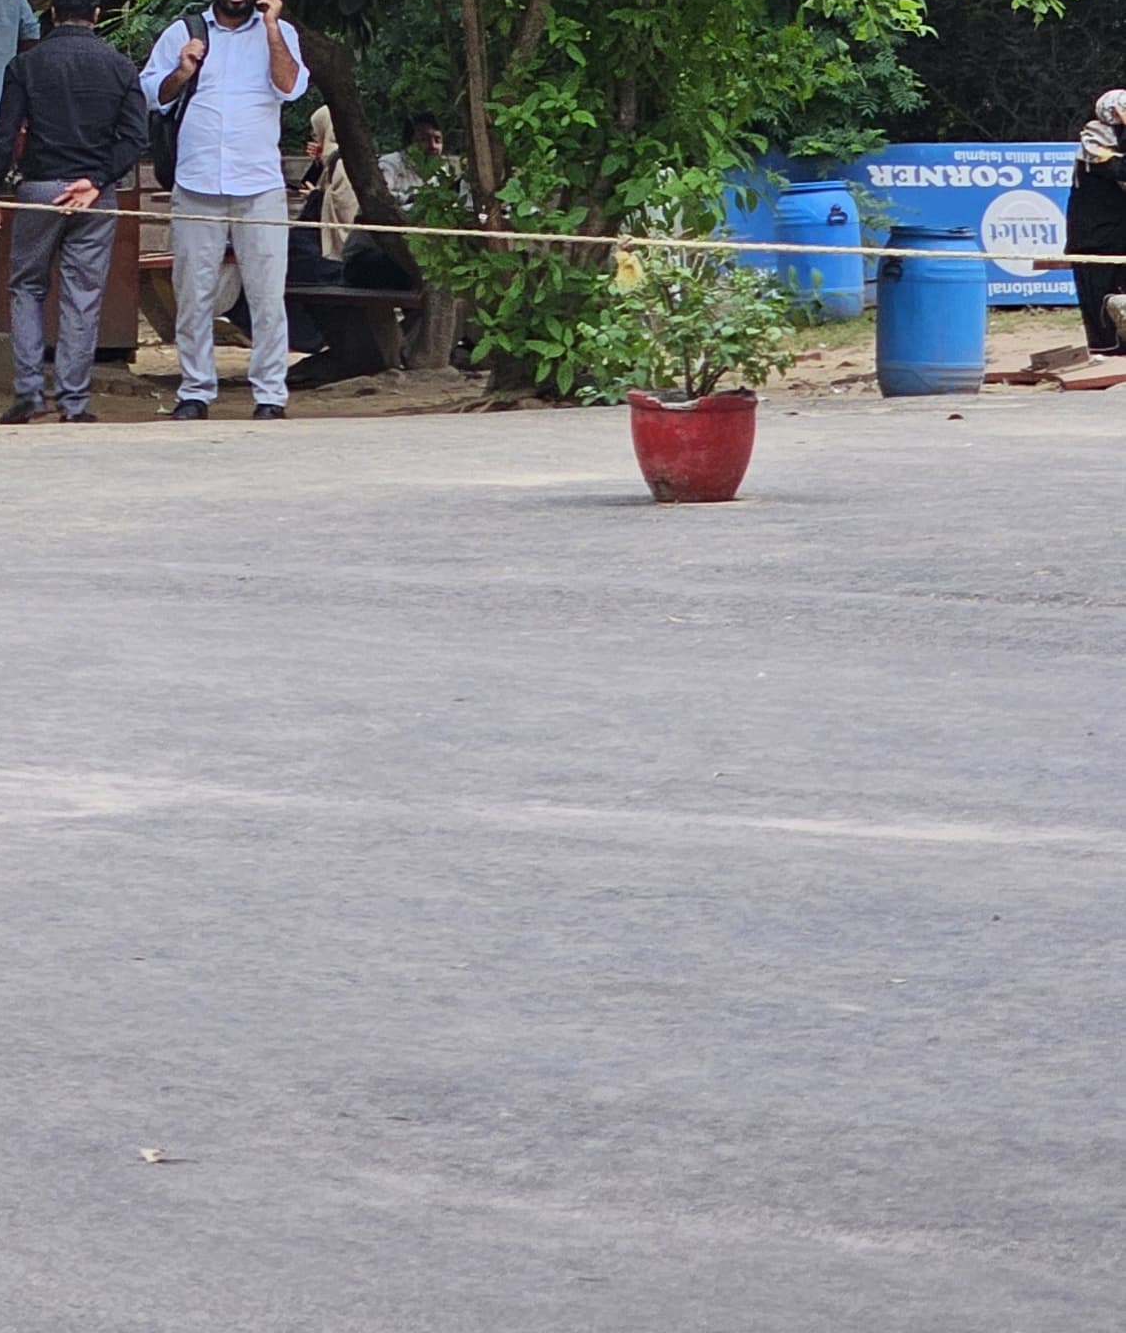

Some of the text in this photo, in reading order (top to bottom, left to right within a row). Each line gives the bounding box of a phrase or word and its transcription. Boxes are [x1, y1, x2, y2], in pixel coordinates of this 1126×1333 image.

[1043, 151, 1075, 163] amia
[866, 165, 1023, 187] CORNER
[989, 223, 1058, 245] Rivlet
[988, 282, 1077, 297] ternational
